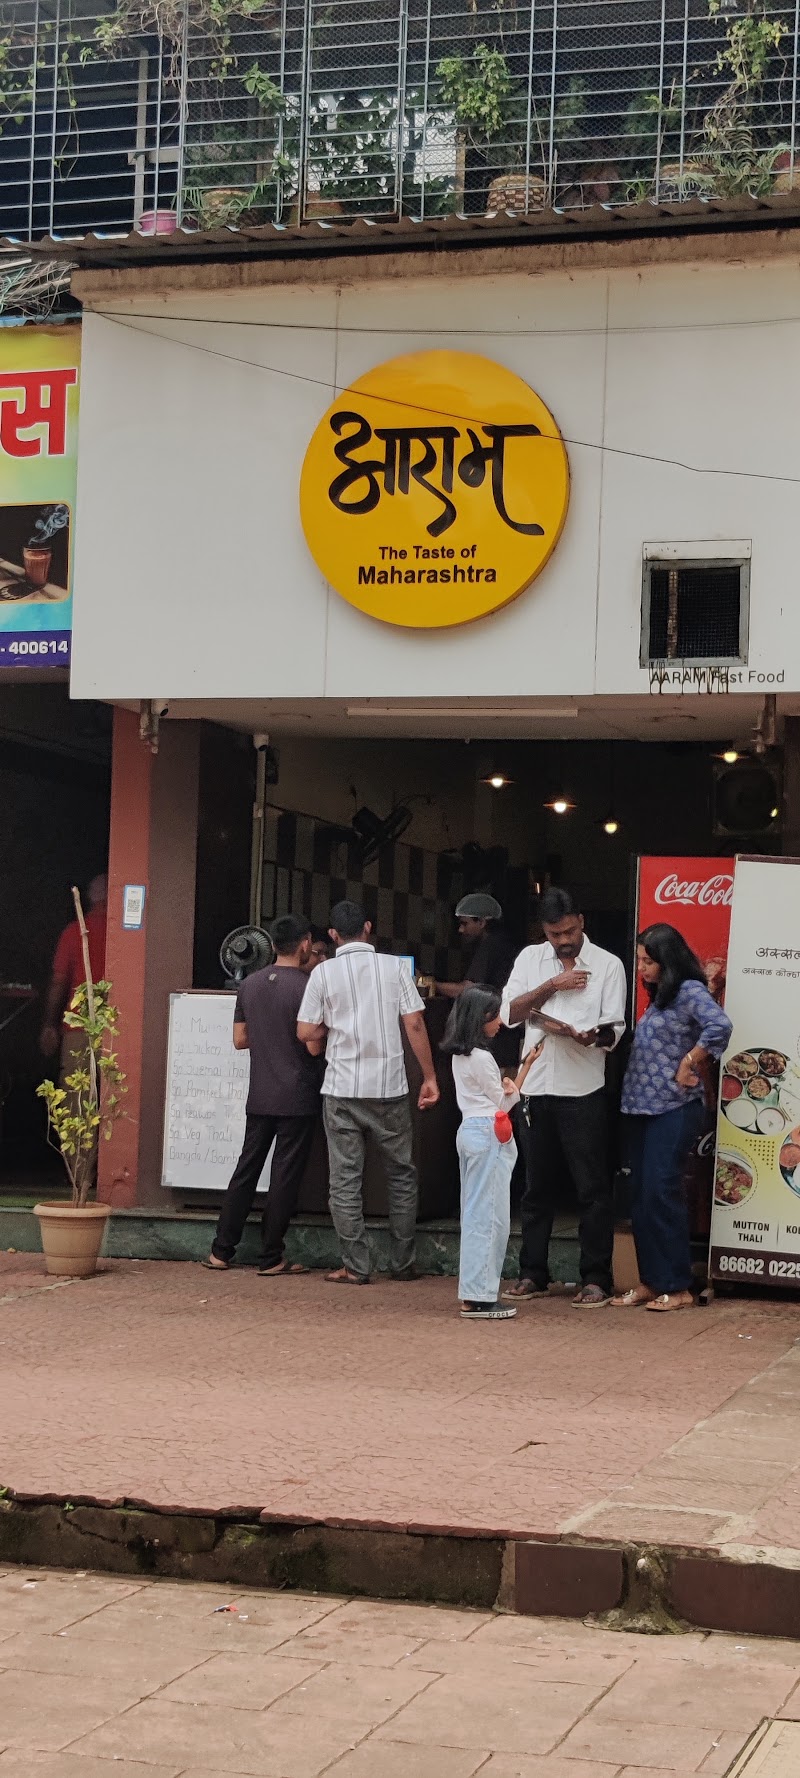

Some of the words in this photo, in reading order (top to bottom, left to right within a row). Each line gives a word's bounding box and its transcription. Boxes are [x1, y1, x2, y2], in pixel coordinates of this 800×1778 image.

[328, 411, 545, 537] आराम
[378, 546, 408, 560] The
[413, 545, 455, 559] Taste
[460, 544, 477, 558] of
[357, 565, 497, 585] Maharashtra
[8, 640, 69, 655] 400614
[651, 671, 706, 684] AARAM
[712, 671, 743, 684] Fast
[748, 669, 785, 683] Food
[654, 873, 735, 906] Coca-Col
[185, 1125, 201, 1146] Veg
[732, 1220, 770, 1231] MUTTON
[737, 1232, 763, 1243] THALI
[718, 1255, 765, 1275] 86682
